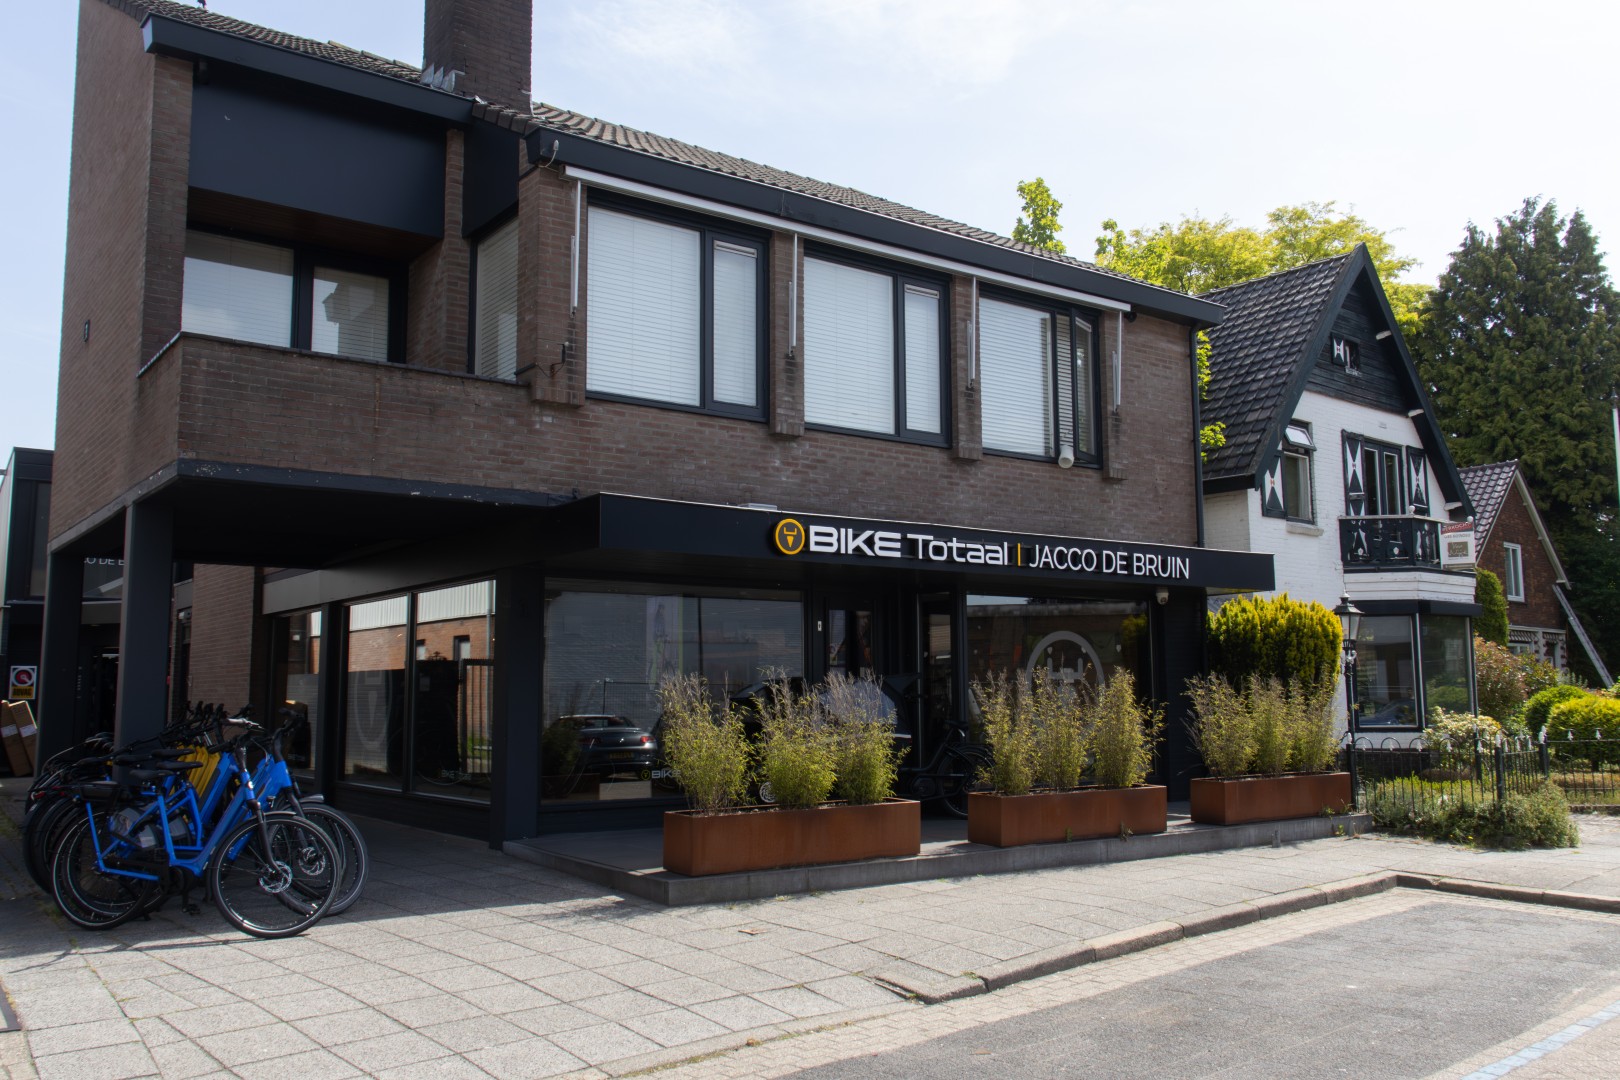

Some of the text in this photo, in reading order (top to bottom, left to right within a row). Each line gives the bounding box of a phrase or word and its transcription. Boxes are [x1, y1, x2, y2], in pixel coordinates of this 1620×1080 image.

[809, 525, 1190, 579] BIKE Totaal JACCO DE BRUIN
